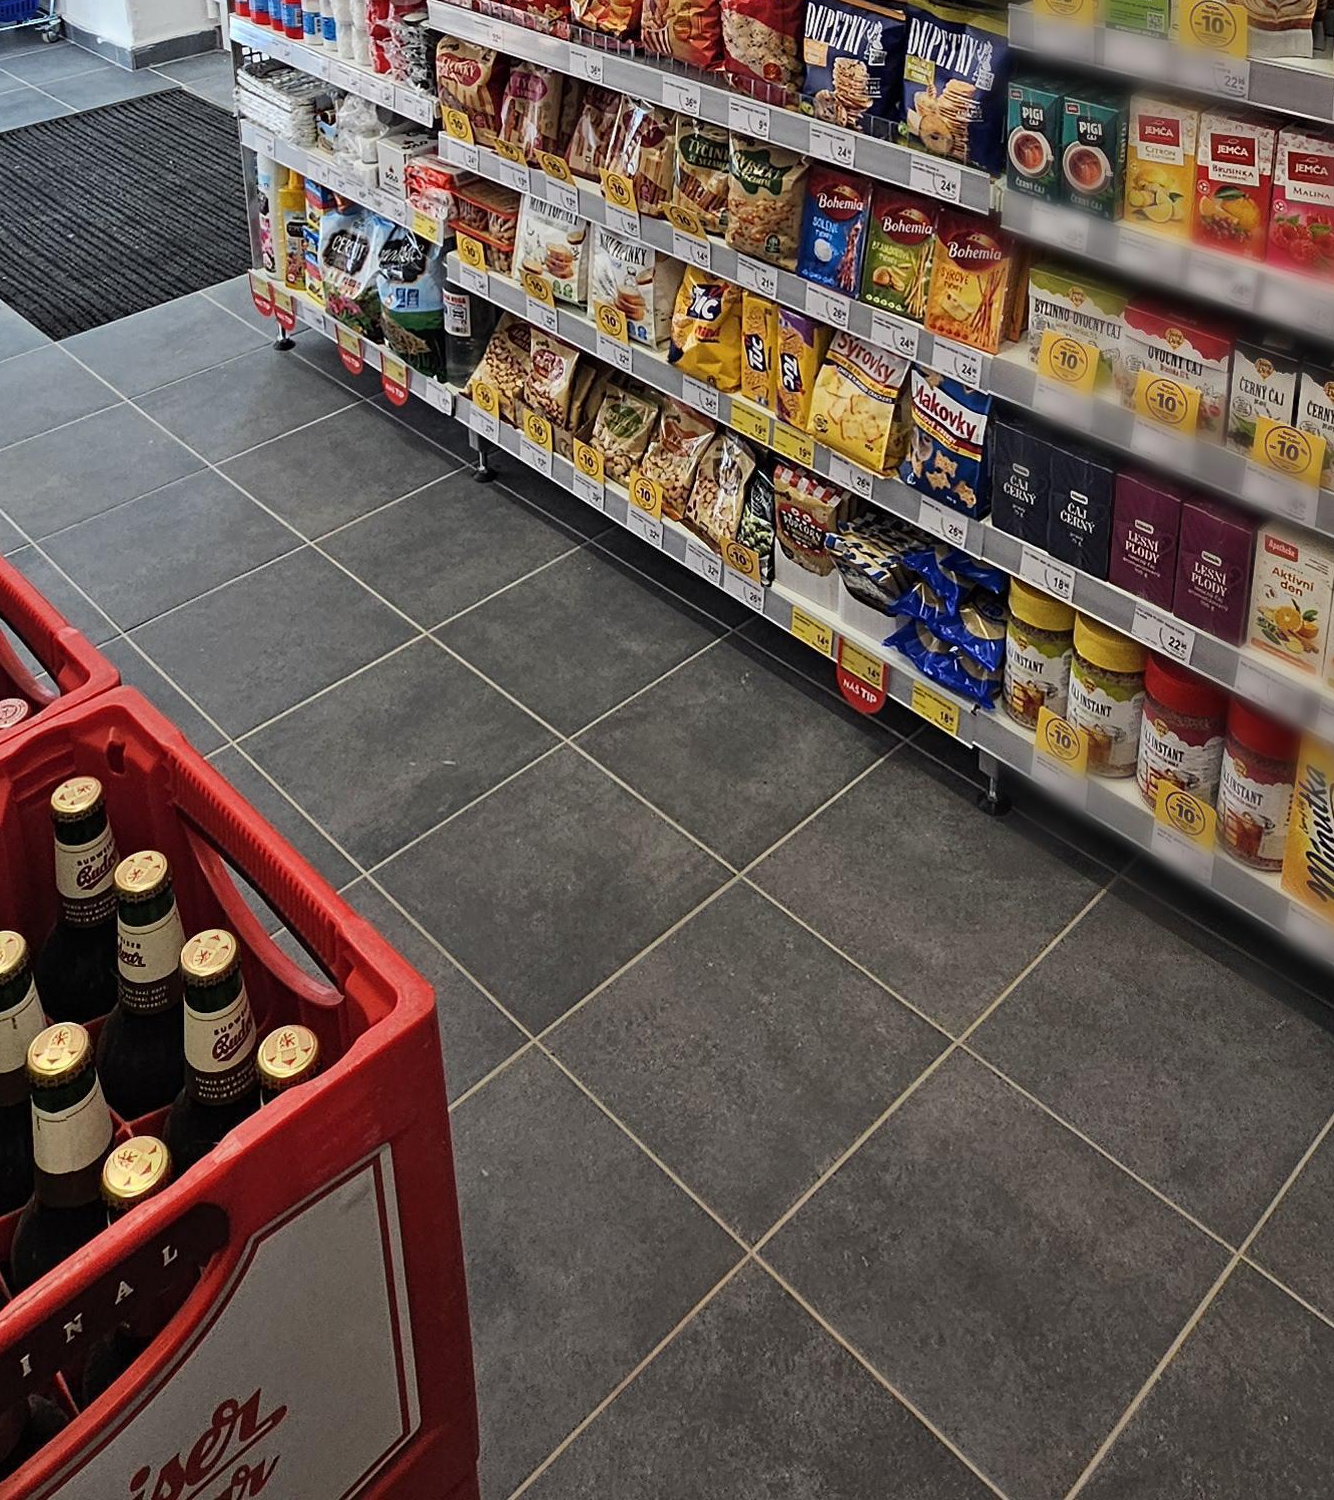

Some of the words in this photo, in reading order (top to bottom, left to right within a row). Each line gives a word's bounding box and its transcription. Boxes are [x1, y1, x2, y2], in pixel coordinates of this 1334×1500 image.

[1022, 107, 1044, 124] PIGI
[1079, 120, 1103, 137] PIGI
[1144, 123, 1174, 139] JEMČA
[1217, 143, 1249, 158] JEMČA
[1295, 163, 1328, 177] JEMČA
[1293, 186, 1331, 200] MALINA
[818, 193, 863, 211] Bohemia
[882, 216, 933, 235] Bohemia
[948, 241, 1002, 261] Bohemia
[1125, 541, 1160, 566] PLODY
[1272, 567, 1315, 592] Aktivní
[1279, 580, 1303, 597] den
